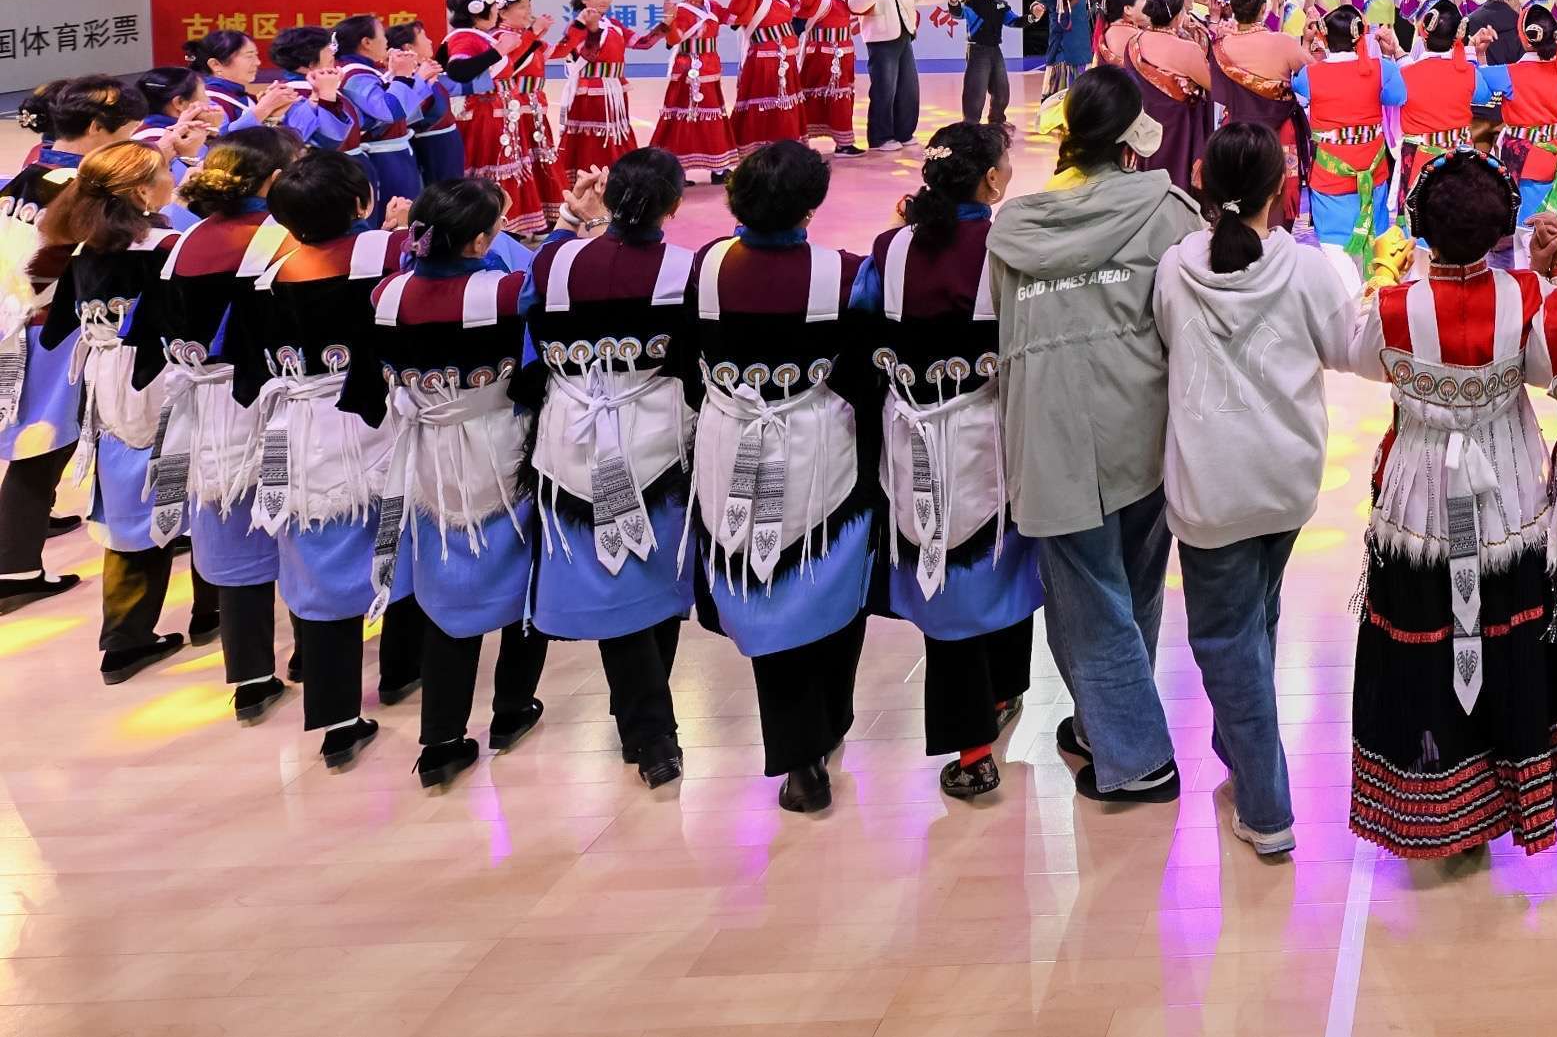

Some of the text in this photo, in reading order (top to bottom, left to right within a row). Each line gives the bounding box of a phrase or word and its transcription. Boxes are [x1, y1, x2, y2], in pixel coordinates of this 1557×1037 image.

[0, 14, 138, 60] 国体育彩票
[1049, 272, 1086, 293] TIMES
[1088, 268, 1131, 285] AHEAD
